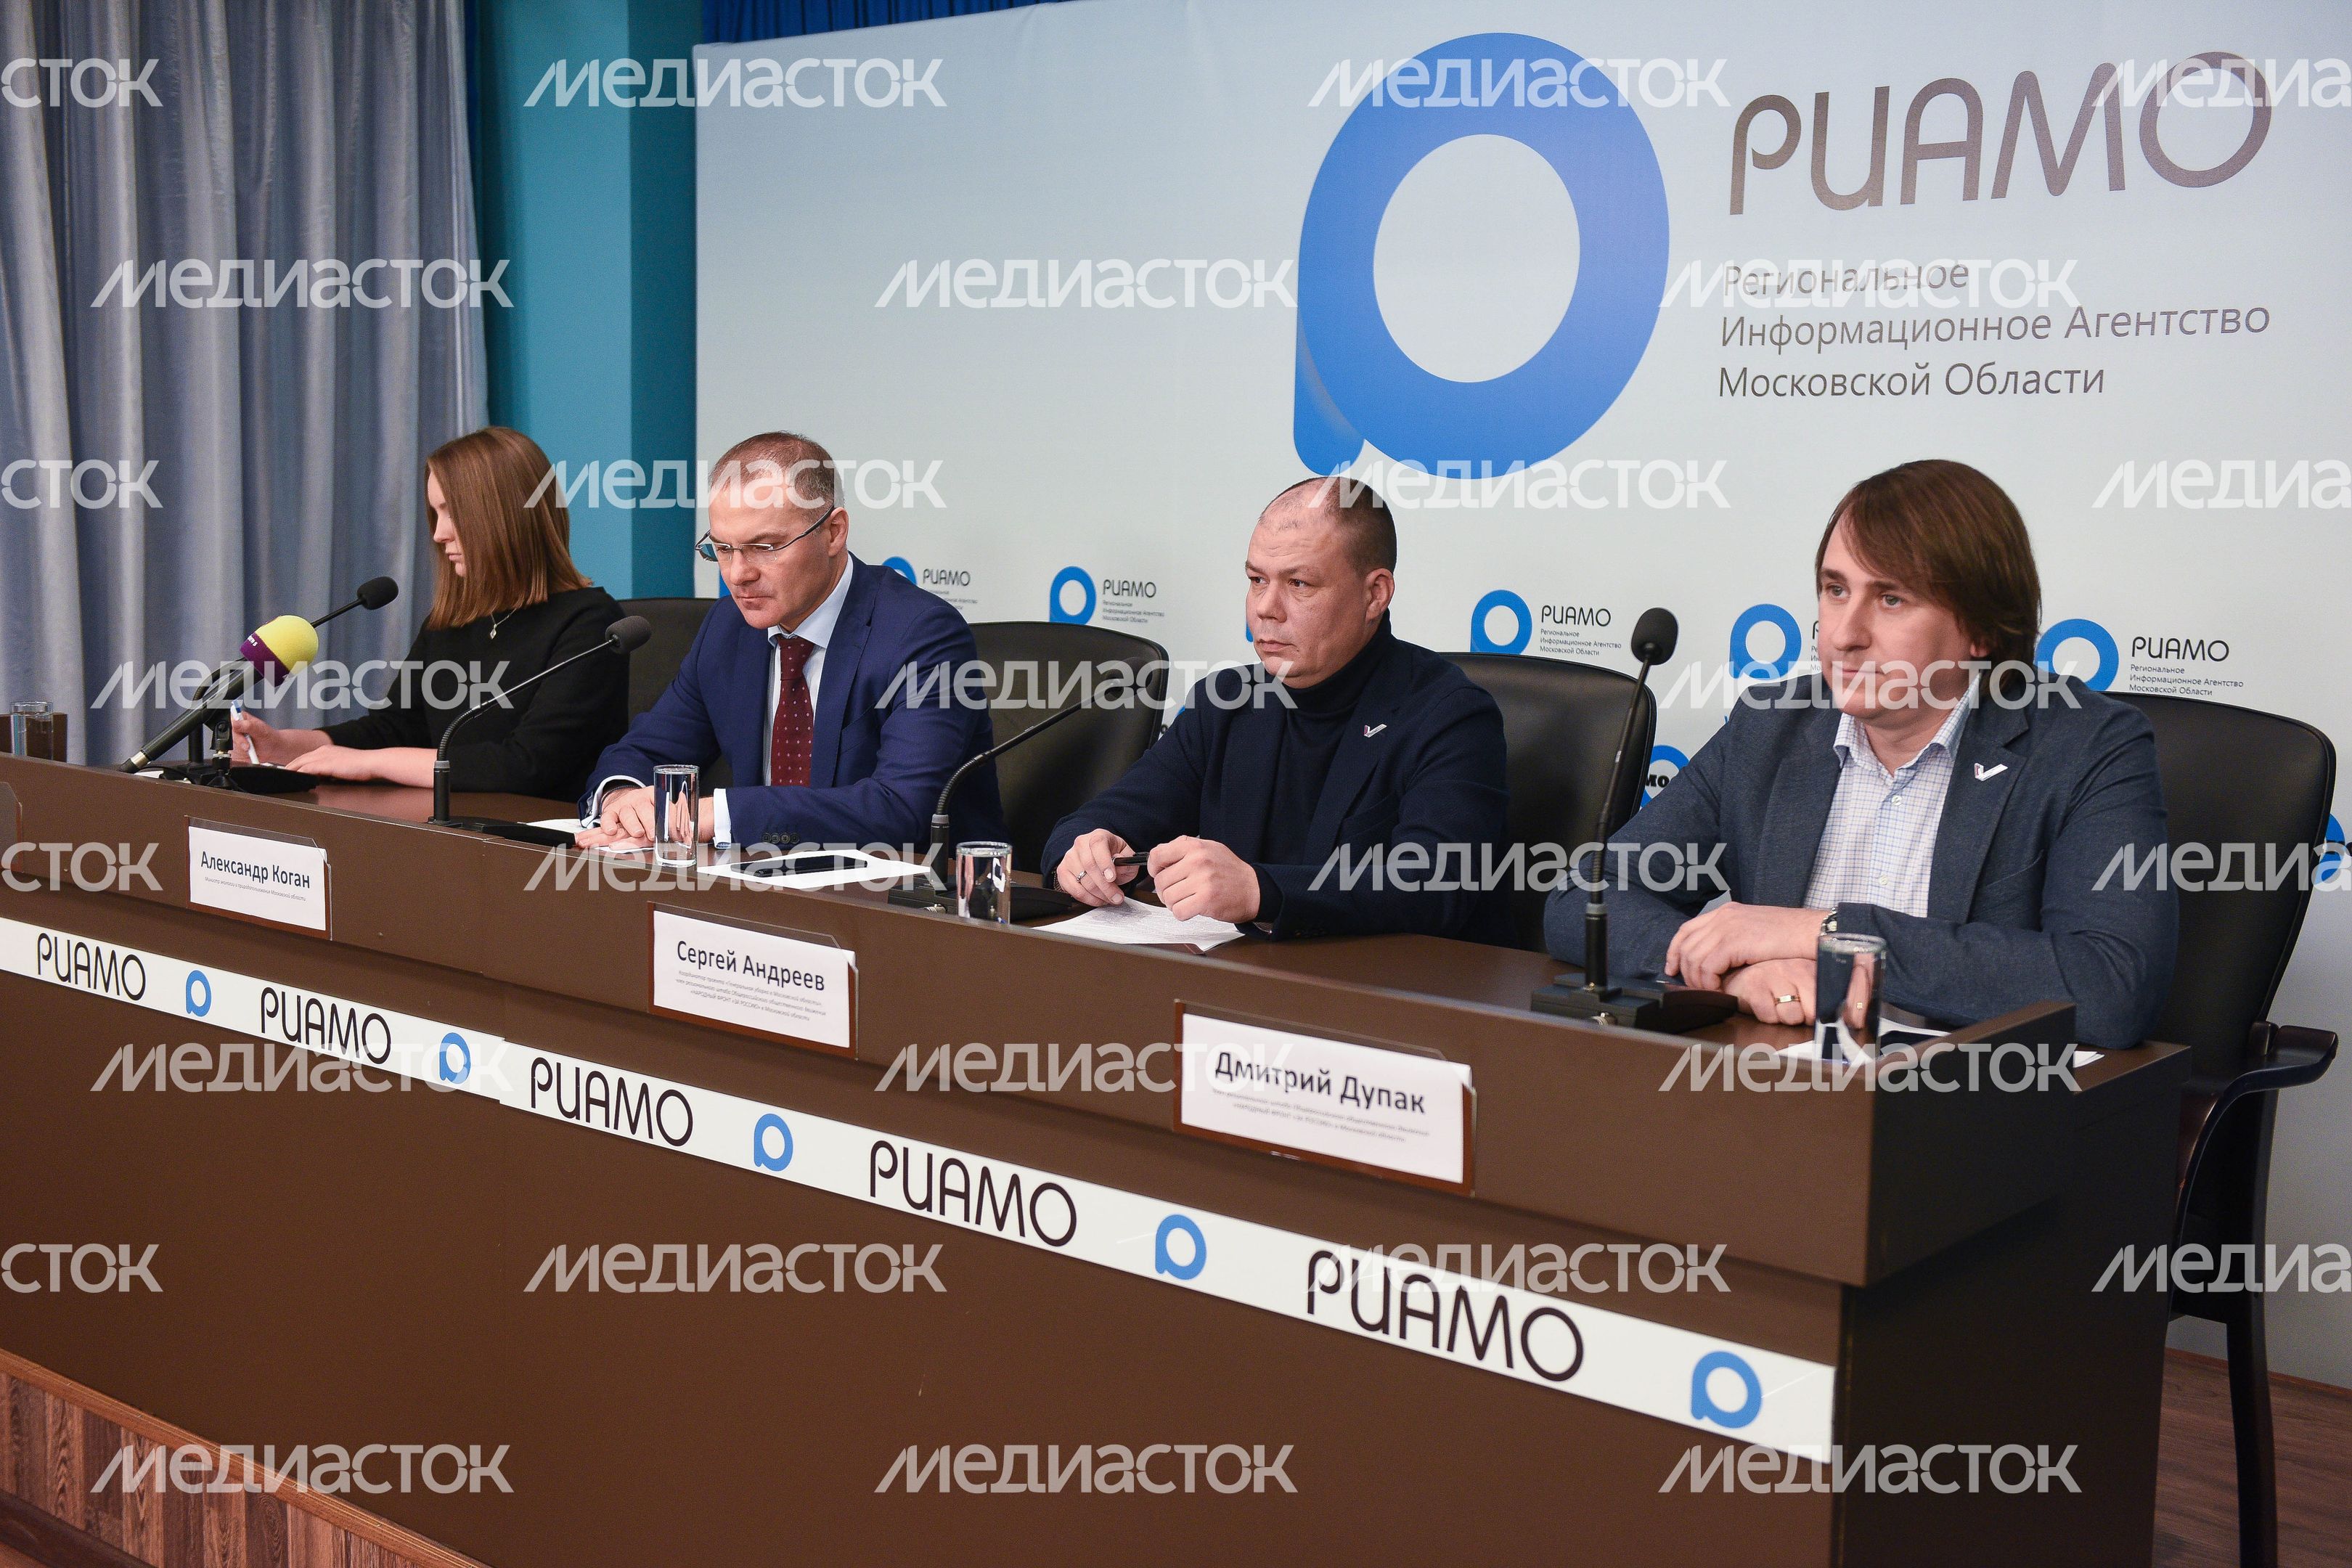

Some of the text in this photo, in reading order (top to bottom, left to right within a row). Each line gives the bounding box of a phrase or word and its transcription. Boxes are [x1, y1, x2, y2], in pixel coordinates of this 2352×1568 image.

[1729, 52, 2272, 216] РИАМО
[1724, 261, 1969, 298] Региональное
[1721, 306, 2271, 354] Информационное Агентство
[1718, 363, 2104, 397] Московской Области
[923, 568, 971, 586] РИАМО
[1103, 579, 1156, 598] РИАМО
[1540, 629, 1580, 637] Региональное
[1541, 605, 1612, 627] РИАМО
[1540, 637, 1622, 649] Информационное Агентство
[1540, 645, 1600, 656] Московской Области
[2131, 636, 2230, 662] РИАМО
[2130, 674, 2245, 687] Информационное Агентство
[2131, 664, 2185, 674] Региональное
[2129, 685, 2213, 695] Московской Области
[201, 851, 310, 889] Александр Коган
[37, 932, 146, 1002] РИАМО
[677, 940, 737, 972] Сергей
[743, 955, 825, 991] Андреев
[261, 987, 392, 1065] РИАМО
[1215, 1052, 1331, 1095] Дмитрий
[1339, 1075, 1426, 1114] Дупак
[531, 1057, 693, 1148] РИАМО
[870, 1140, 1077, 1247] РИАМО
[1307, 1250, 1584, 1382] РИАМО
